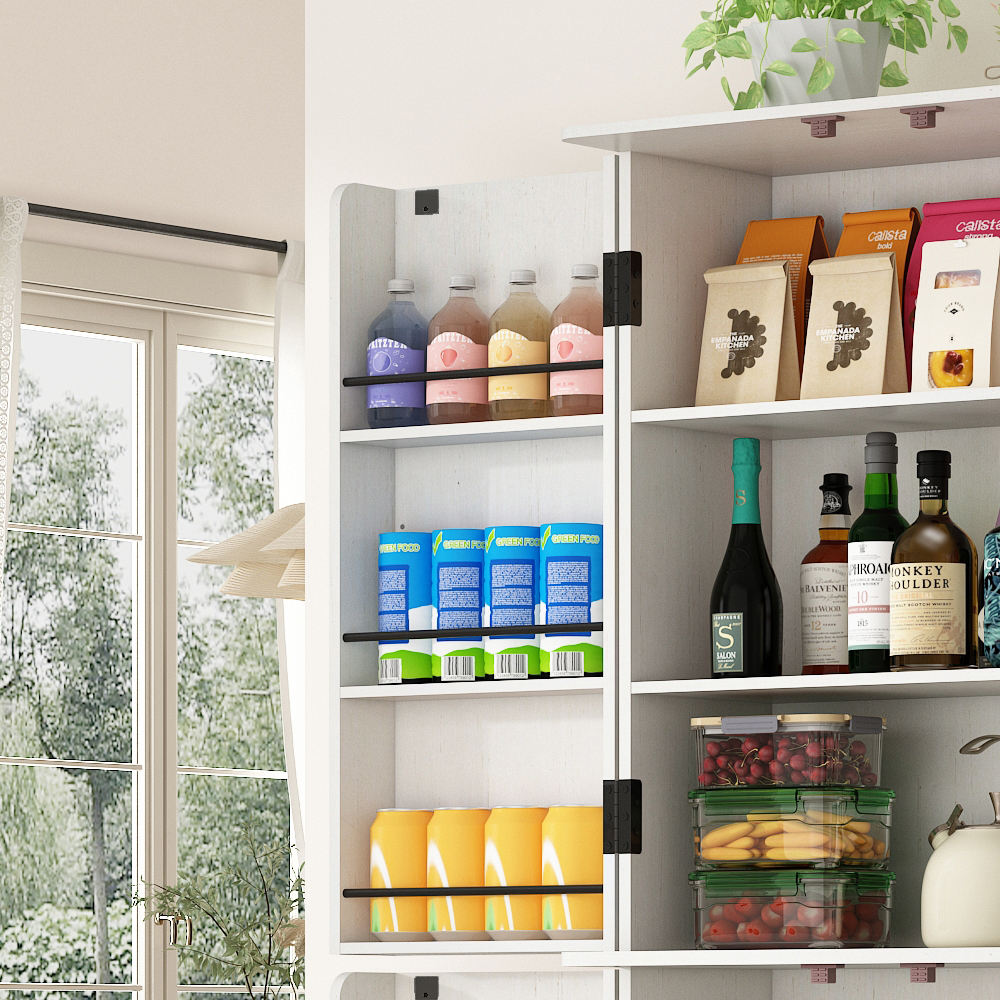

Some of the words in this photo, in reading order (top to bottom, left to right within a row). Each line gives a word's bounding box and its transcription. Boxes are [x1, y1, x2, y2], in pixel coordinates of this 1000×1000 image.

[876, 242, 893, 250] bold
[815, 326, 861, 336] EMPANADA
[710, 334, 755, 344] EMPANADA
[820, 333, 856, 342] KITCHEN
[715, 341, 749, 350] KITCHEN
[735, 489, 747, 506] S
[496, 536, 523, 547] GREEN
[551, 533, 579, 544] GREEN
[579, 534, 600, 545] FOOD
[397, 543, 421, 553] FOOD
[442, 540, 471, 550] GREEN
[857, 590, 869, 604] 10
[811, 620, 822, 631] 12
[715, 623, 735, 650] S
[716, 651, 737, 660] SALON
